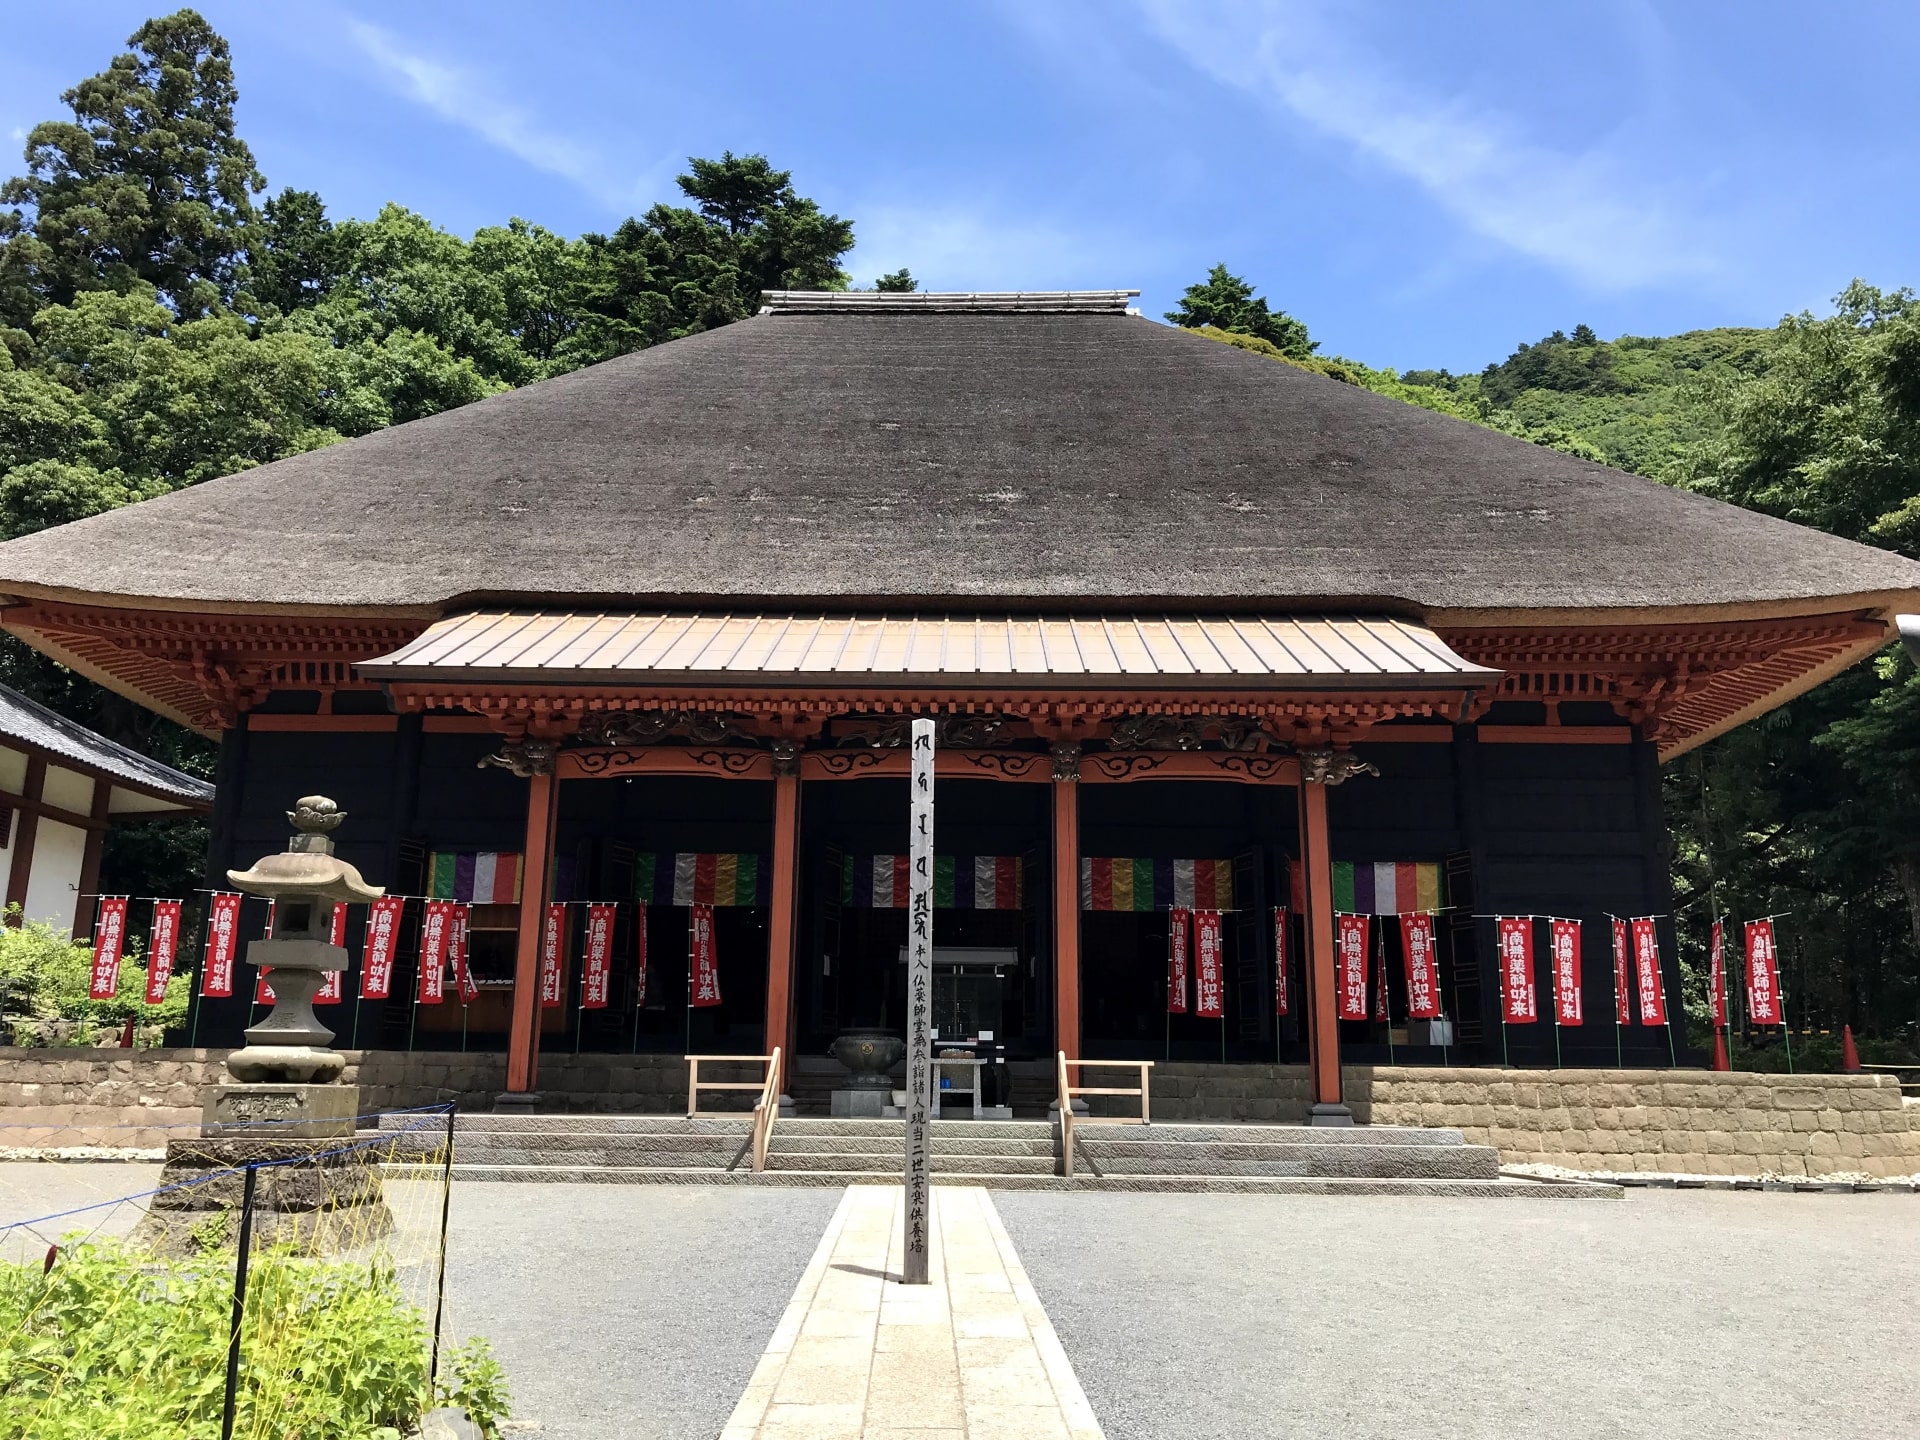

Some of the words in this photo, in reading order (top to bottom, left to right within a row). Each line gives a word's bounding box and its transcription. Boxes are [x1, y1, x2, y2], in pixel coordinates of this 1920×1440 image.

[1200, 925, 1220, 1011] 南無薬師如来
[1410, 927, 1433, 1011] 南無薬師如来
[1640, 934, 1658, 1018] 南無薬師如来
[1752, 935, 1774, 1018] 南無薬師如来
